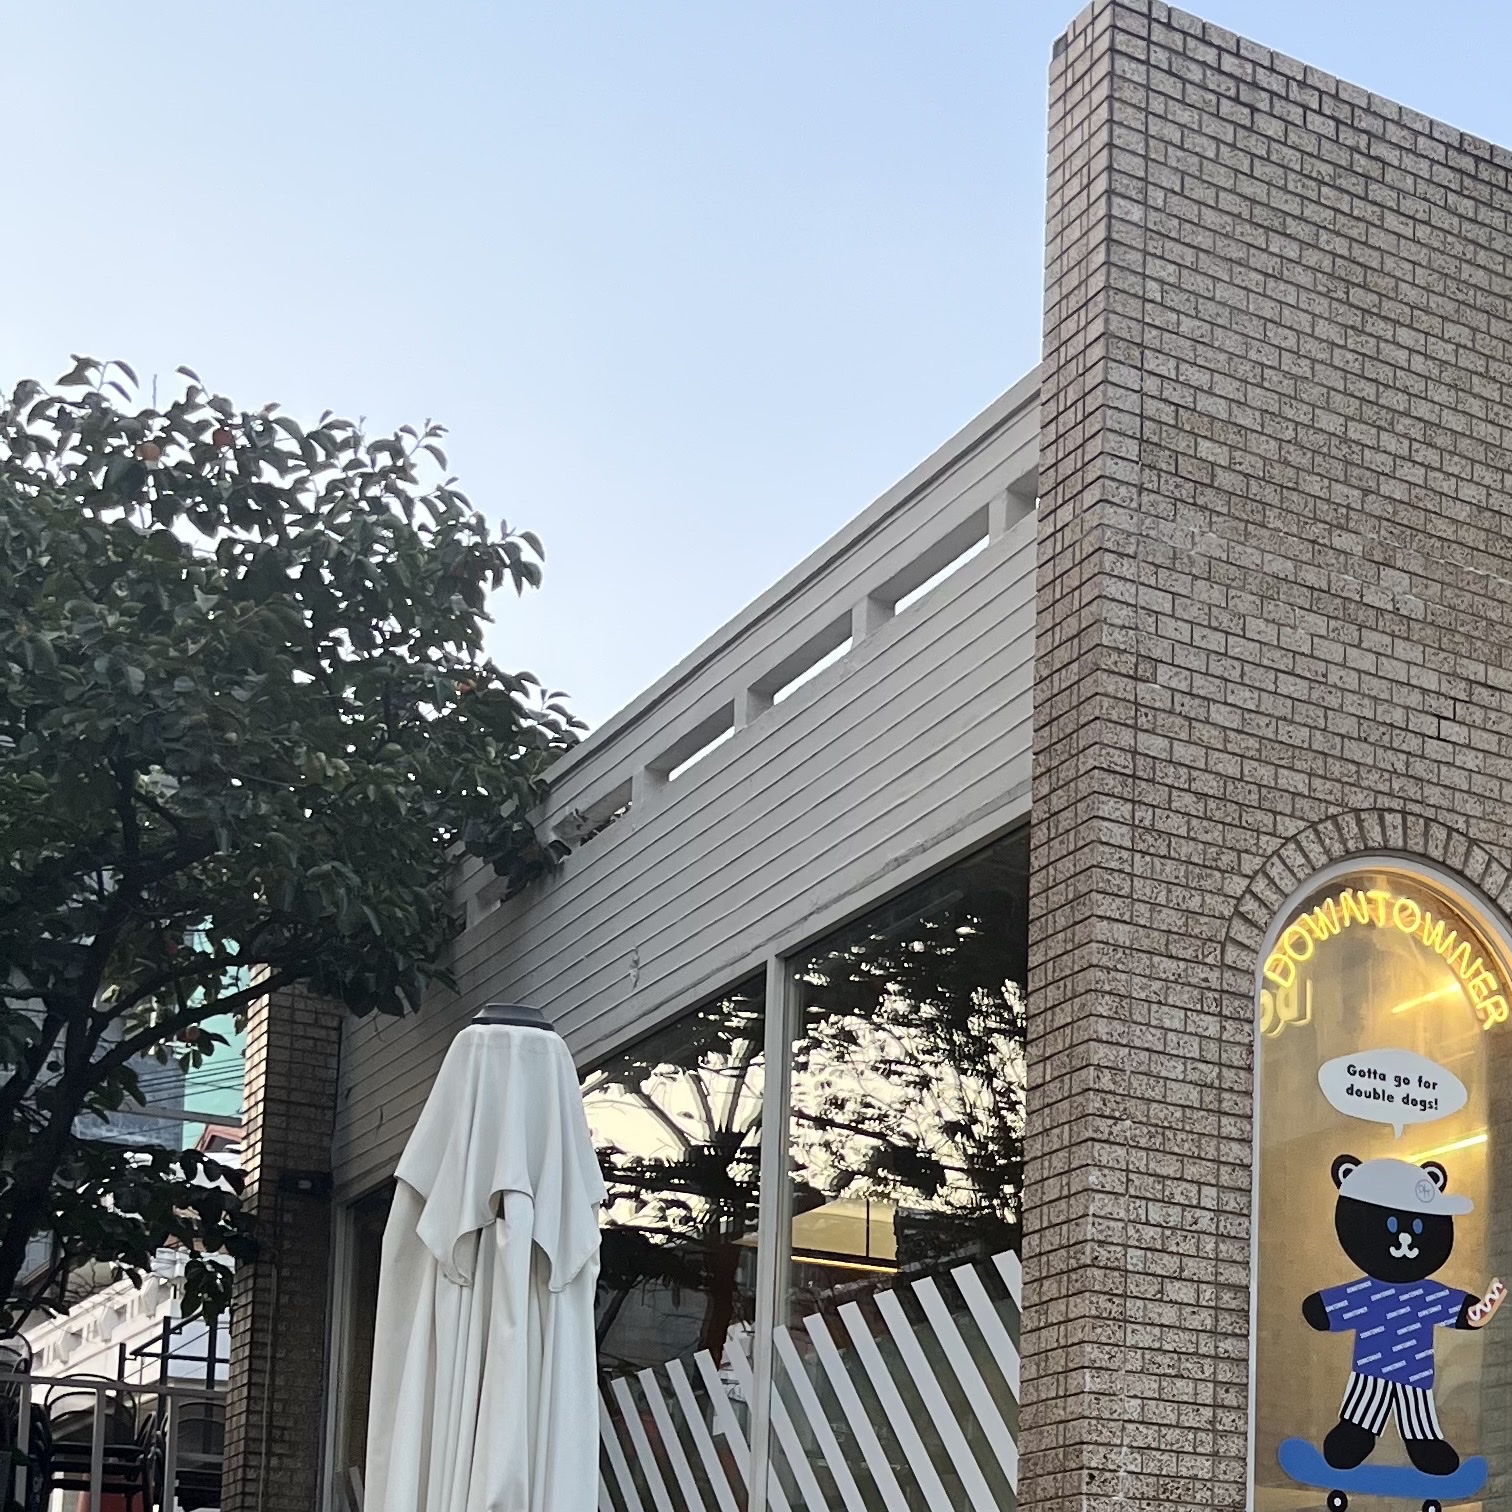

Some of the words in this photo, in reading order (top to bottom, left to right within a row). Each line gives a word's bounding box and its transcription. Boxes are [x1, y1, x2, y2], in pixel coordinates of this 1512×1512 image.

[1264, 888, 1509, 1031] DOWNTOWNER
[1346, 1064, 1387, 1082] Gotta
[1394, 1075, 1411, 1088] go
[1418, 1075, 1438, 1091] for
[1346, 1084, 1395, 1103] double
[1402, 1093, 1439, 1112] dogs!
